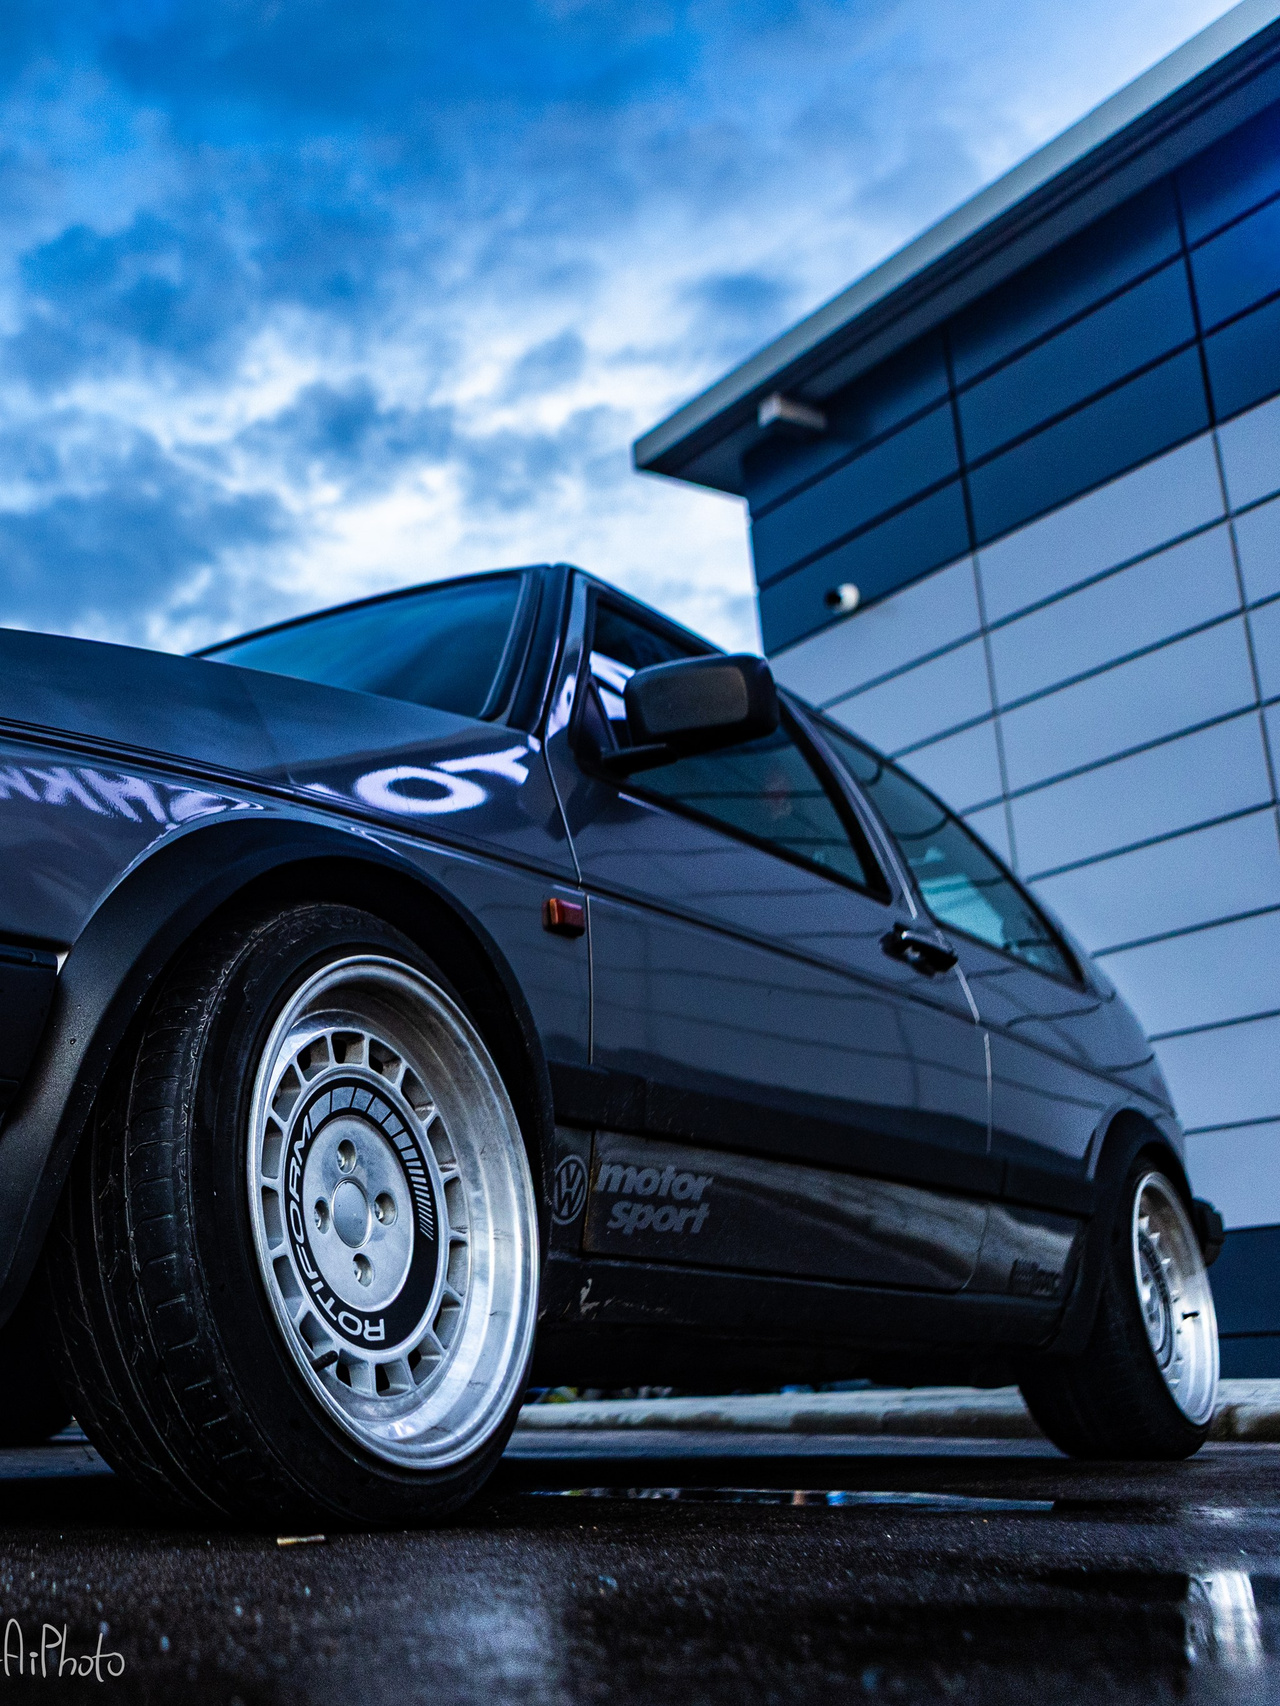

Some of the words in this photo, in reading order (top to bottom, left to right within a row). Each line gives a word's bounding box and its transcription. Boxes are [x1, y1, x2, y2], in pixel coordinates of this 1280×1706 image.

[593, 1163, 714, 1201] motor
[288, 1114, 386, 1342] ROTIFORM
[606, 1200, 710, 1236] sport
